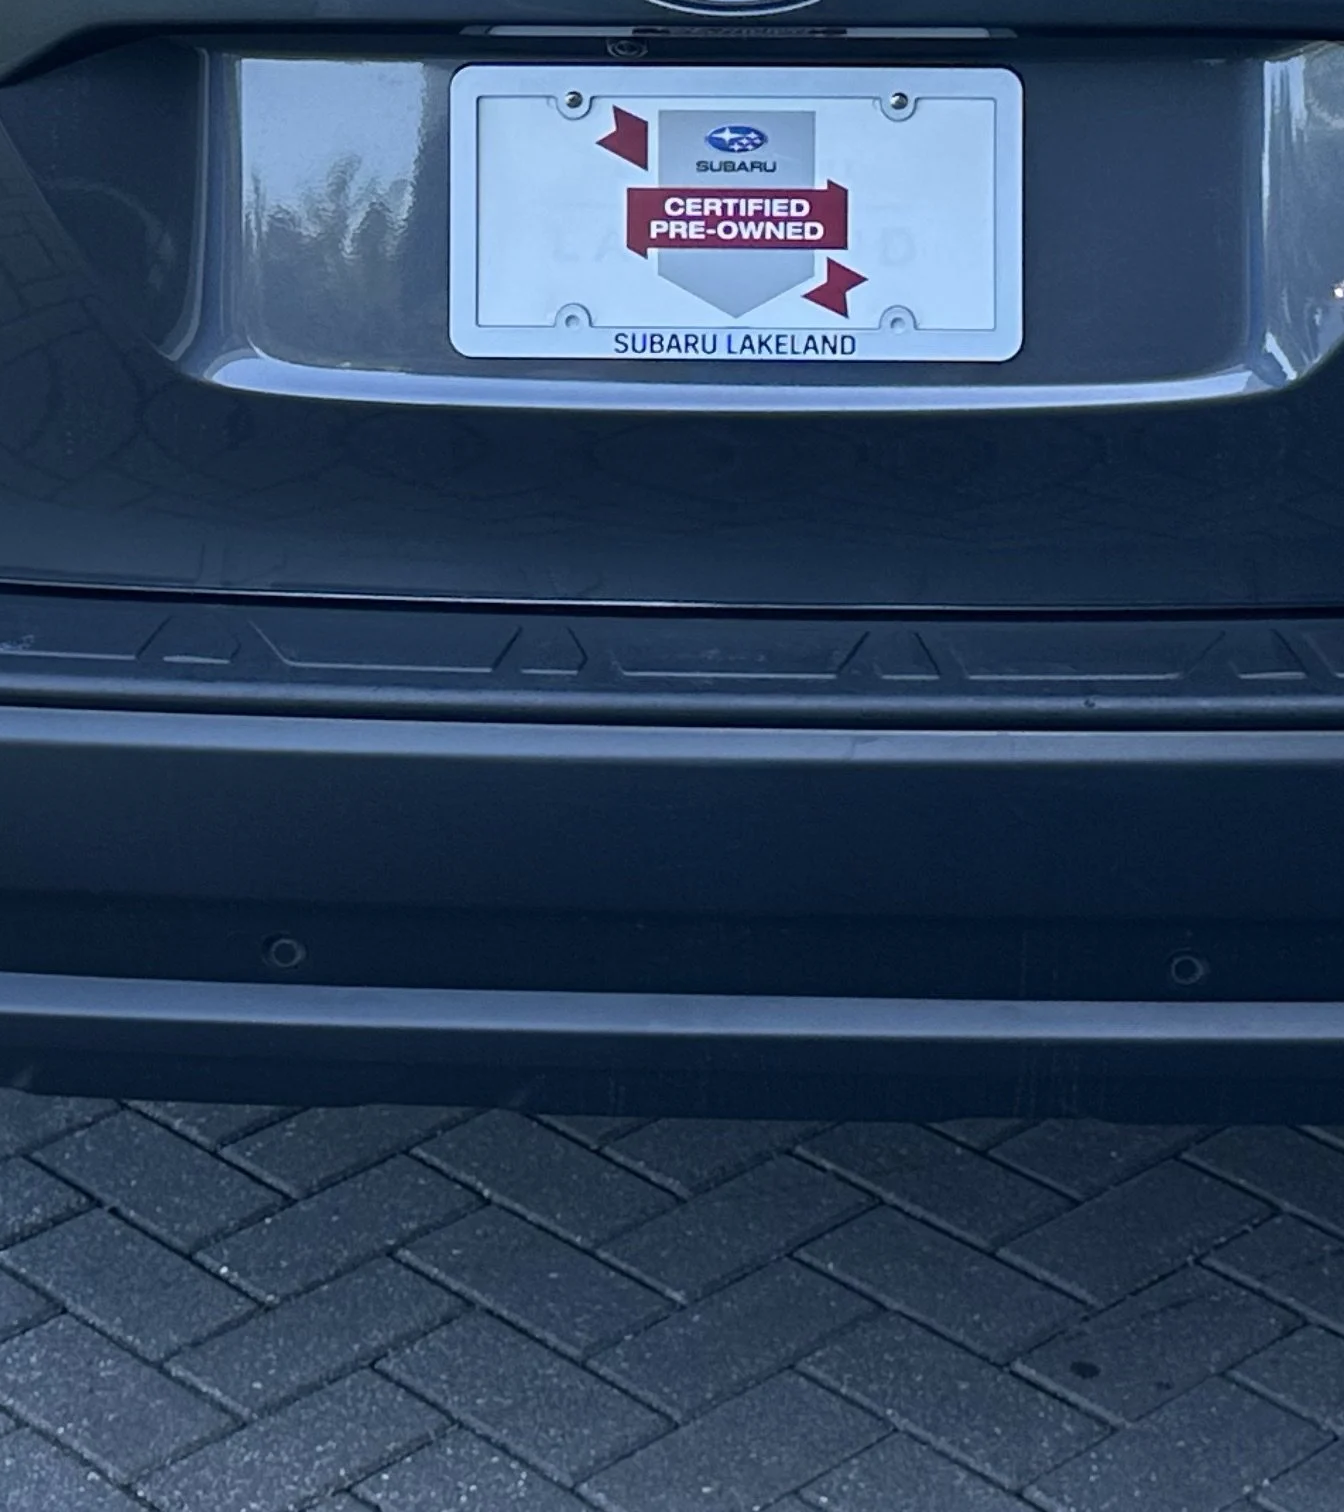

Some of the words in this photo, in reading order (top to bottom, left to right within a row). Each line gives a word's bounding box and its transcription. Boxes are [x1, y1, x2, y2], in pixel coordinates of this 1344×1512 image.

[696, 160, 777, 173] SUBARU
[664, 197, 810, 217] CERTIFIED
[650, 220, 824, 240] PRE-OWNED
[614, 332, 718, 355] SUBARU
[727, 333, 856, 356] LAKELAND
